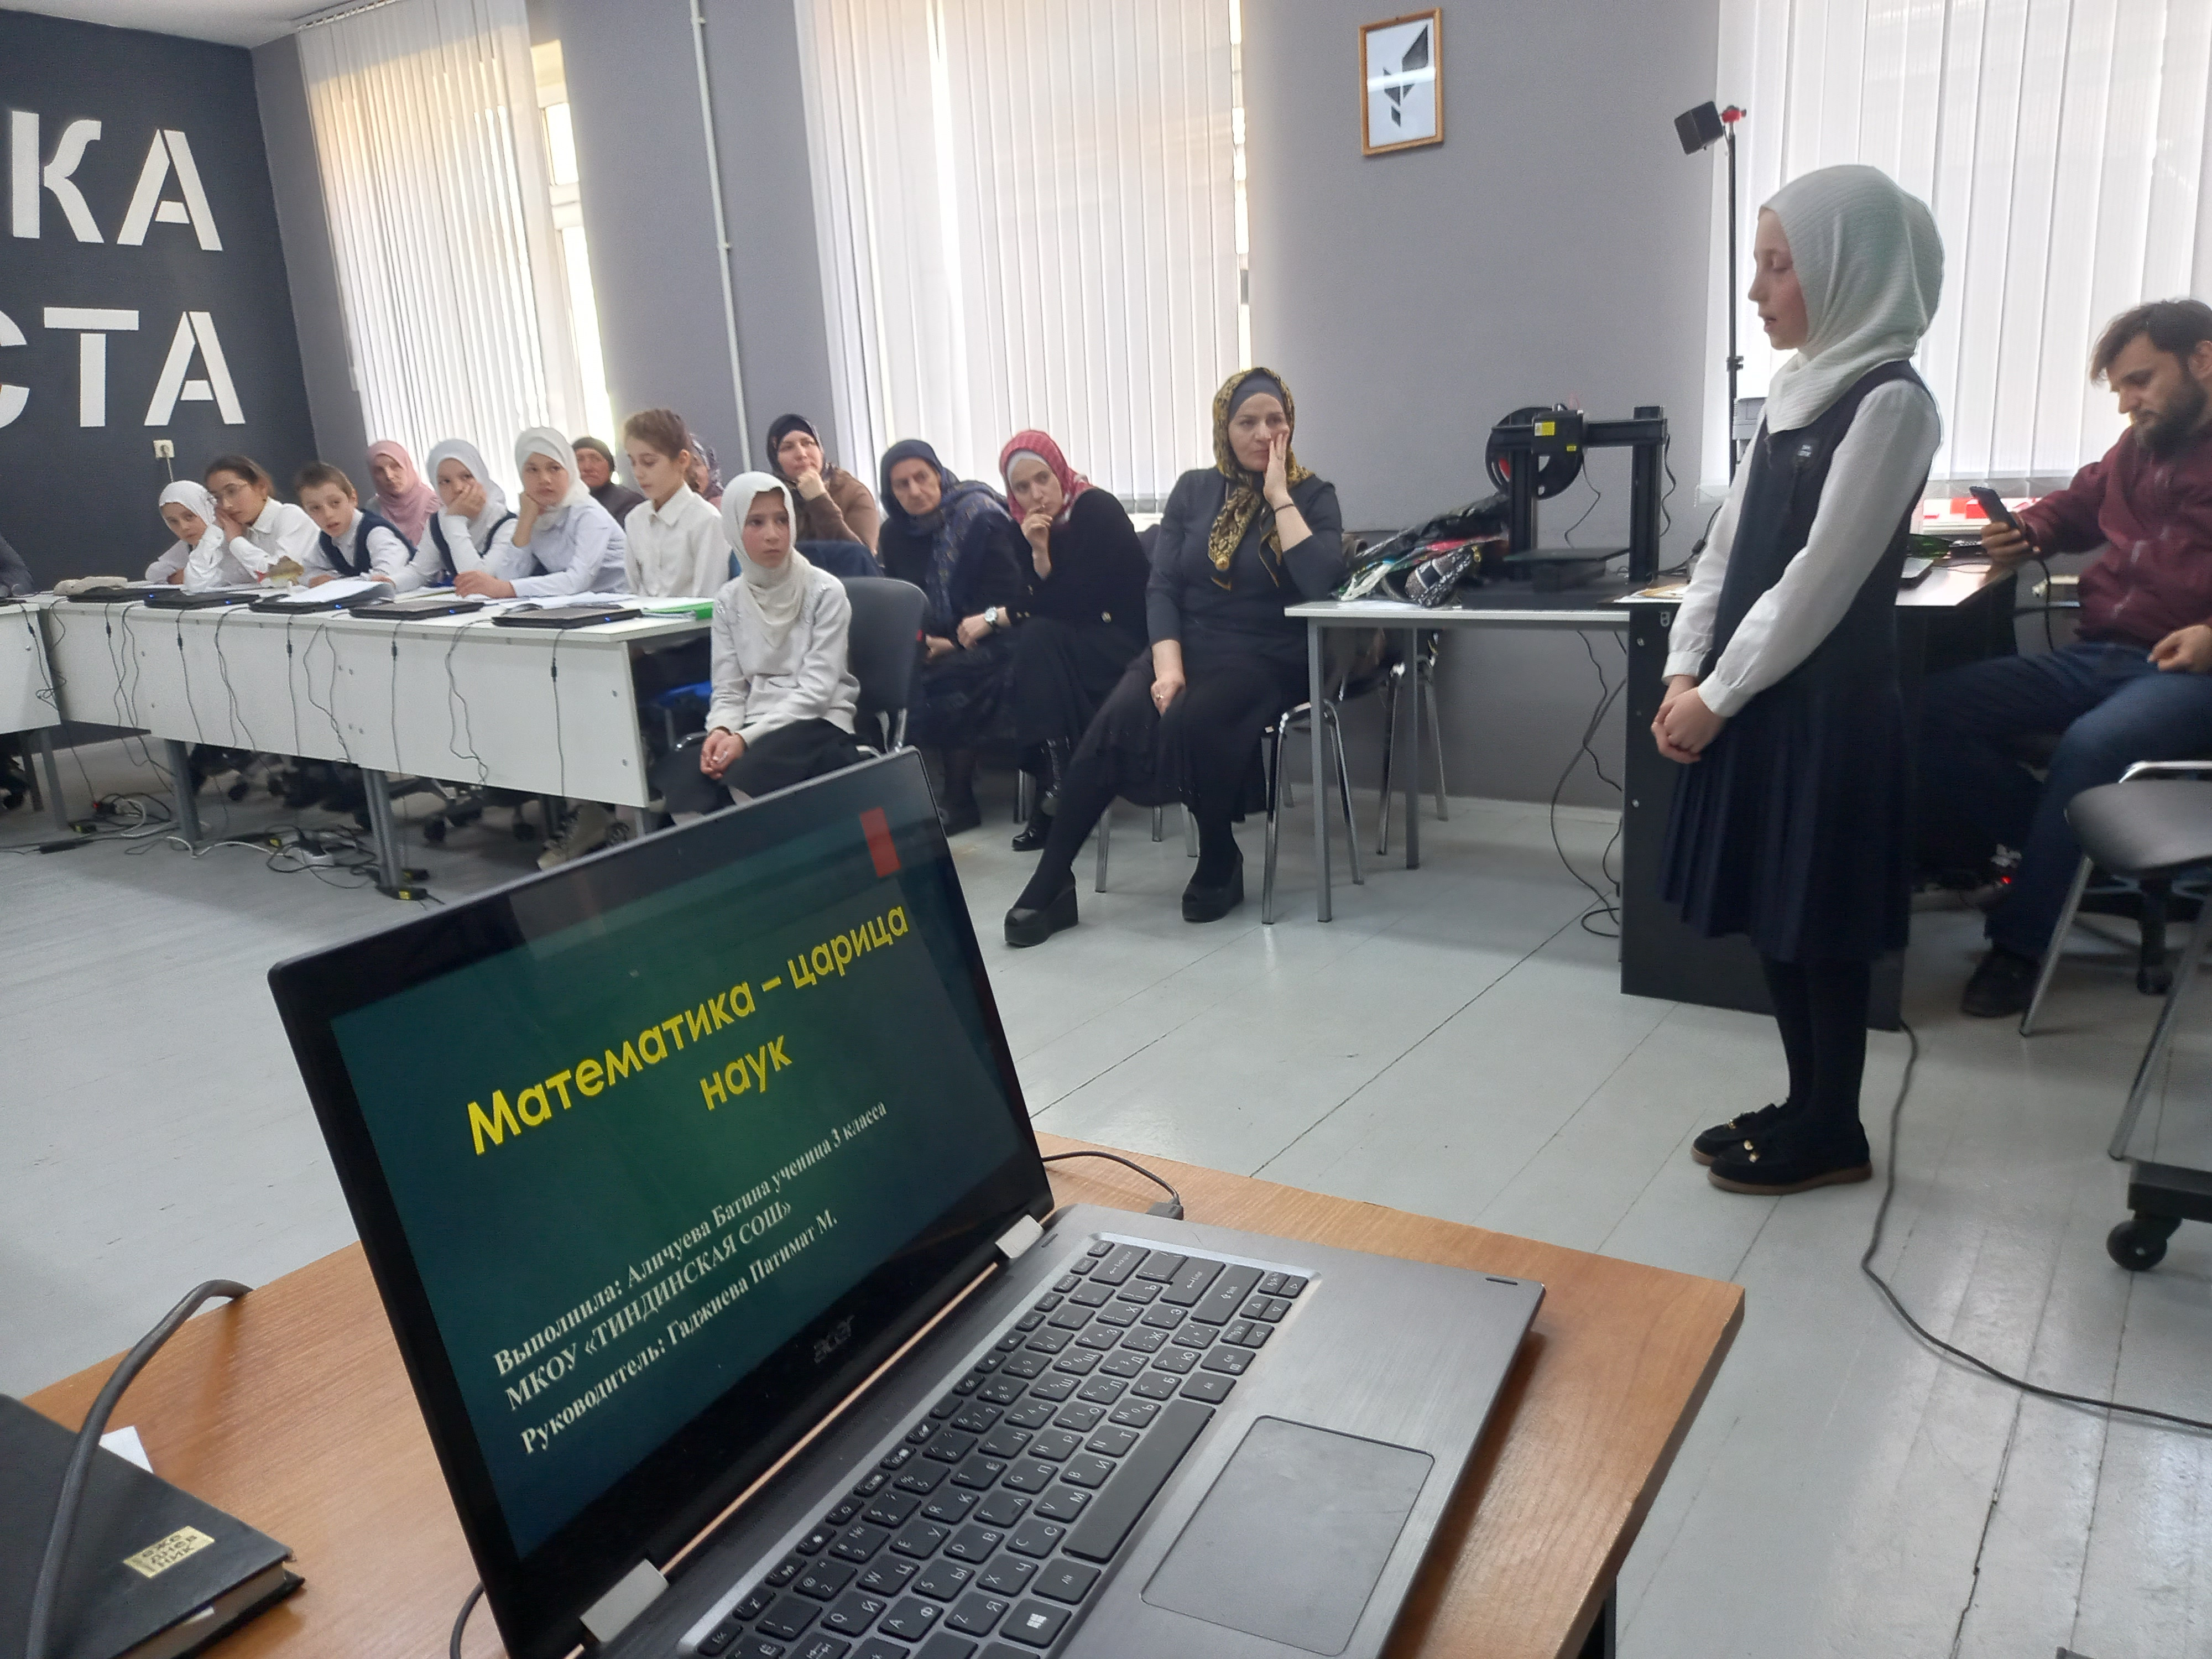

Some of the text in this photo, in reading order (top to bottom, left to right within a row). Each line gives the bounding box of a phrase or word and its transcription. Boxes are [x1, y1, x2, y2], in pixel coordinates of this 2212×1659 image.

[12, 111, 222, 251] КА
[467, 980, 756, 1156] Математика
[787, 906, 909, 990] царица
[698, 1035, 792, 1110] наук
[492, 1280, 623, 1376] Выполнила:
[628, 1220, 712, 1288] Аличуева
[771, 1136, 832, 1193] ученица
[831, 1128, 842, 1148] 3
[842, 1101, 886, 1140] класса
[505, 1201, 791, 1411] МКОУ «ТИНДИНСКАЯ СОШ»
[520, 1209, 838, 1454] Руководитель: Гаджиева Патимат М.
[1149, 1332, 1164, 1341] Ж
[1083, 1353, 1099, 1361] Щ
[1131, 1356, 1145, 1364] Д
[1181, 1352, 1195, 1361] Ю
[1059, 1379, 1074, 1387] Ш
[1116, 1411, 1130, 1420] M
[1013, 1432, 1027, 1441] Н
[1062, 1435, 1073, 1443] Р
[1037, 1465, 1052, 1474] П
[1095, 1460, 1110, 1469] И
[1070, 1492, 1085, 1503] М
[928, 1505, 943, 1514] R
[981, 1510, 993, 1518] F
[982, 1532, 997, 1542] В
[1015, 1538, 1029, 1546] C
[952, 1544, 965, 1553] D
[895, 1564, 914, 1575] Ц
[1015, 1562, 1032, 1572] Ч
[864, 1571, 881, 1584] W
[950, 1567, 967, 1580] Ы
[985, 1574, 1000, 1584] X
[821, 1584, 833, 1592] 2
[921, 1580, 935, 1589] S
[862, 1600, 879, 1612] Й
[986, 1600, 1002, 1612] Я
[920, 1606, 933, 1617] Ф
[831, 1613, 848, 1623] Q
[954, 1614, 968, 1624] Z
[889, 1619, 904, 1629] A
